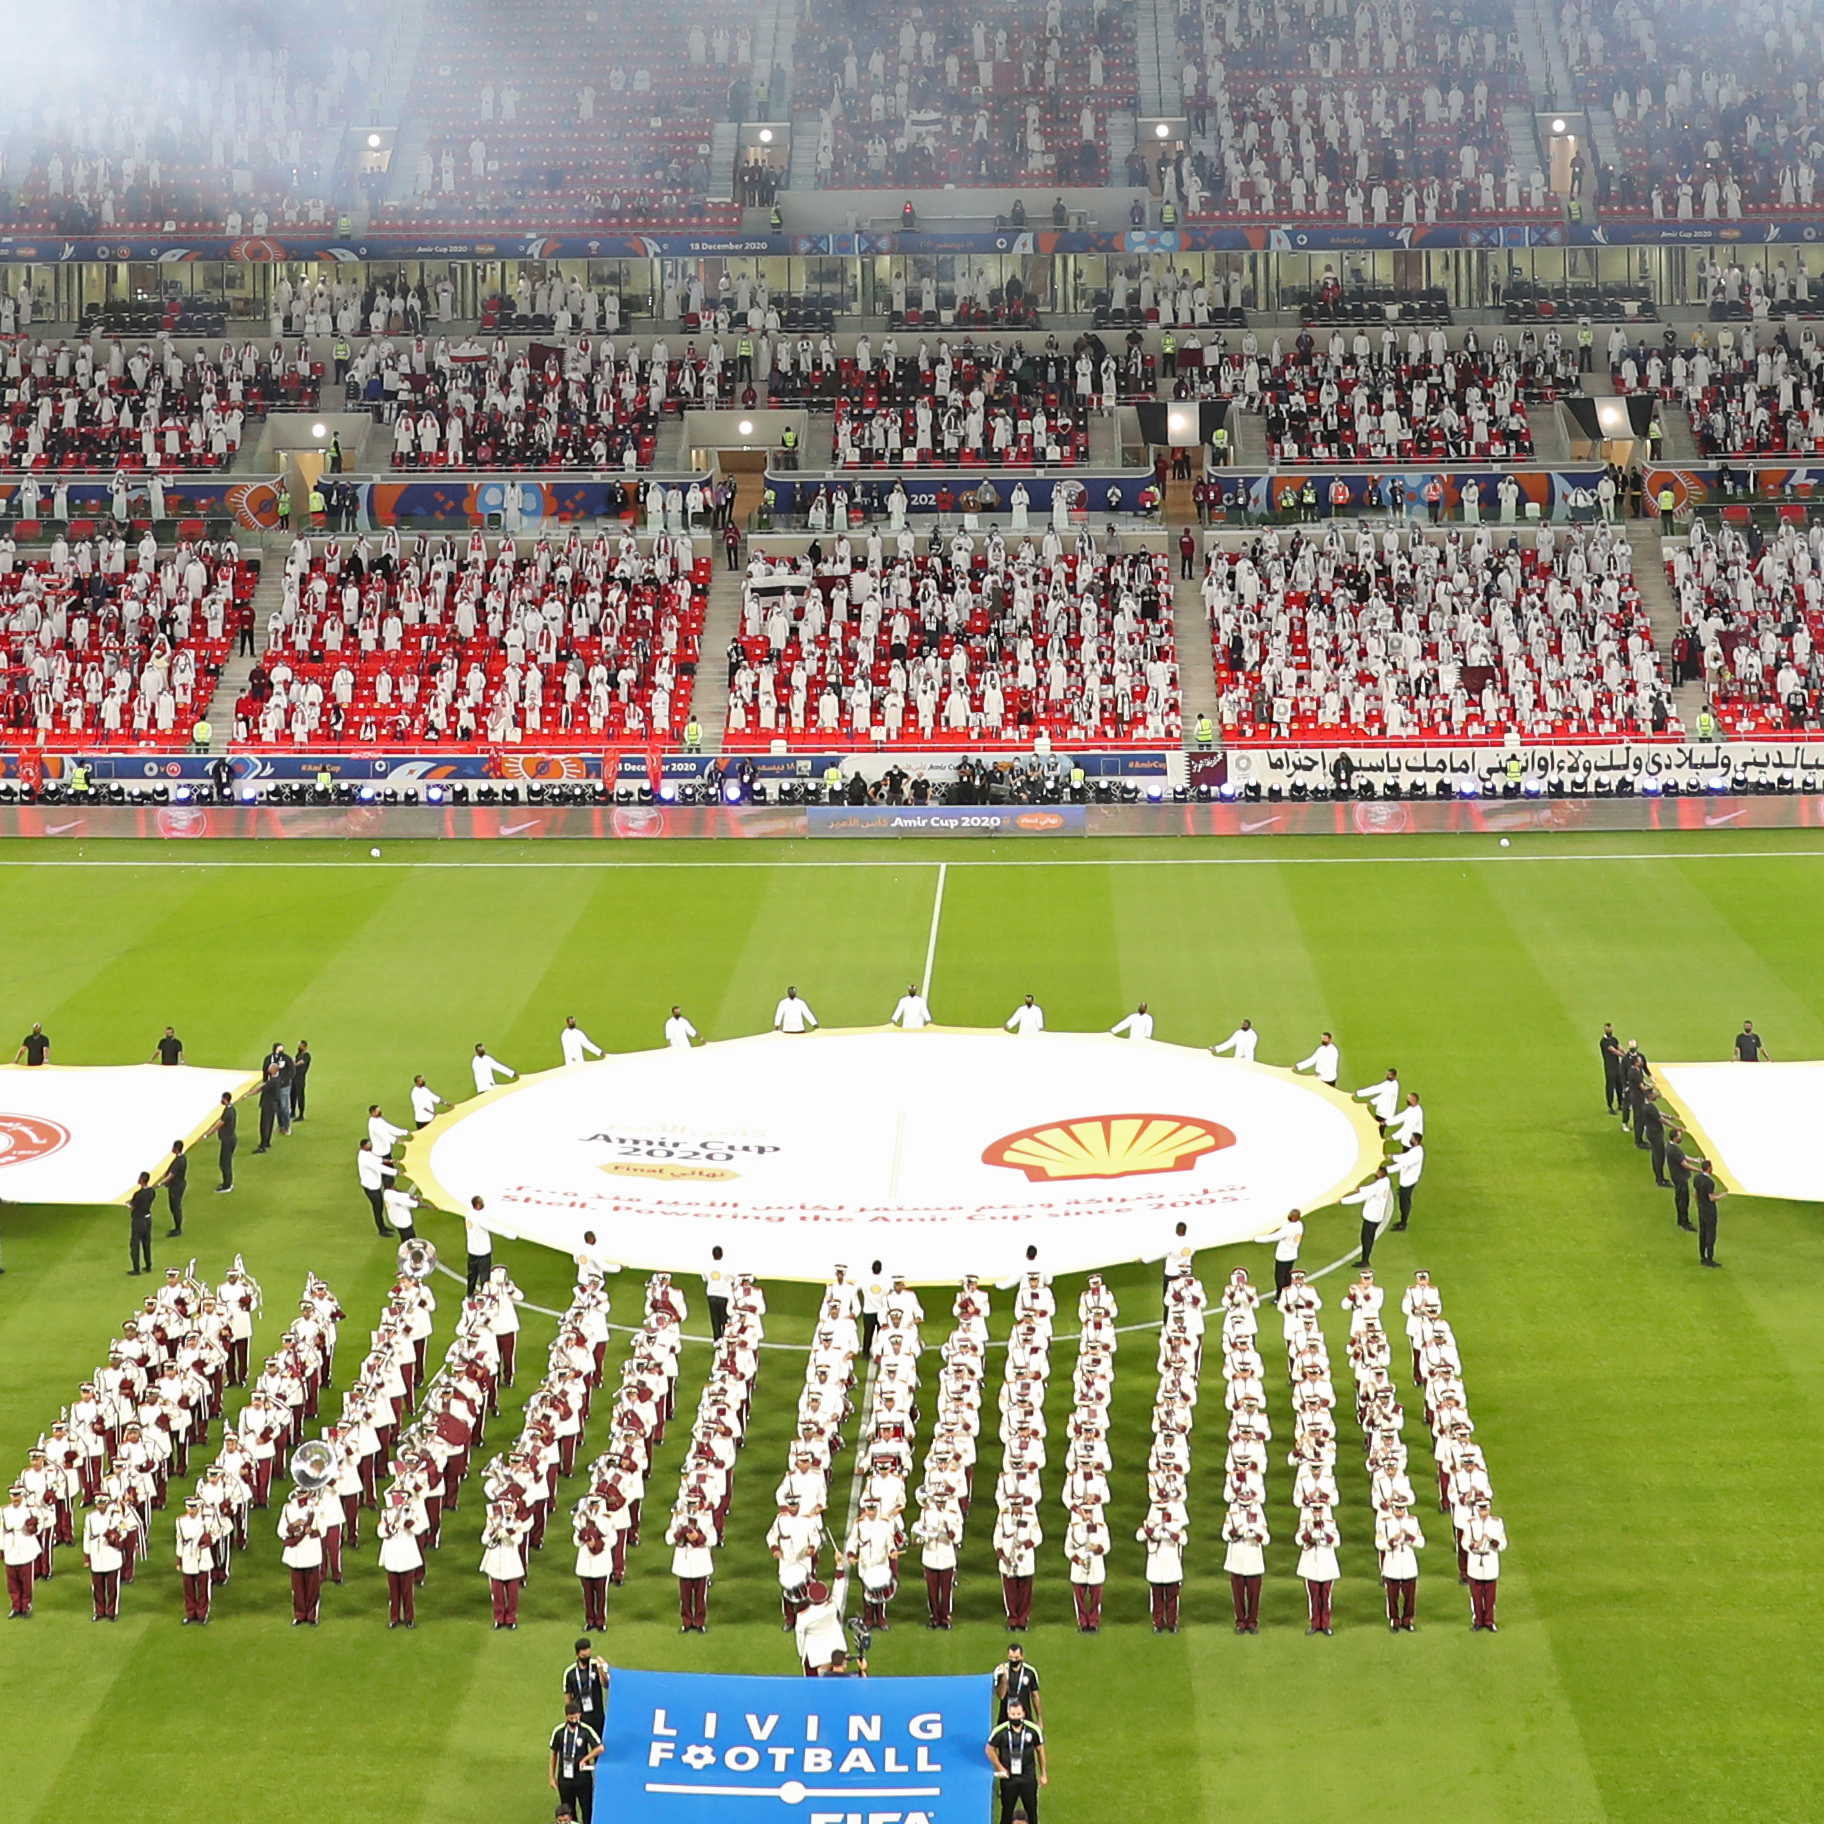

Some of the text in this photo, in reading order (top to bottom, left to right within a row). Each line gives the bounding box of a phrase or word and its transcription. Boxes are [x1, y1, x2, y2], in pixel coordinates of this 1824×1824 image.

[1661, 230, 1678, 239] Amir
[1679, 230, 1693, 239] Cup
[1693, 230, 1712, 239] 2020
[416, 244, 433, 254] Amir
[434, 244, 447, 254] Cup
[448, 244, 468, 254] 2020
[689, 241, 767, 251] 18 December 2020
[910, 494, 937, 505] 202
[300, 765, 341, 773] #AmiCup
[624, 762, 696, 771] Deceer 2020
[927, 763, 947, 771] Amir
[828, 817, 889, 829] كأس الأمير
[891, 817, 928, 828] Amir
[930, 817, 959, 829] Cup
[961, 817, 1001, 827] 2020
[578, 1133, 781, 1155] Amir Cup
[617, 1146, 735, 1162] 2020
[613, 1165, 664, 1174] Final
[612, 1205, 785, 1223] Powering
[799, 1214, 854, 1222] the
[868, 1214, 953, 1223] Amir
[966, 1213, 1032, 1221] Cup
[1047, 1207, 1133, 1218] since
[651, 1707, 944, 1741] LIVING
